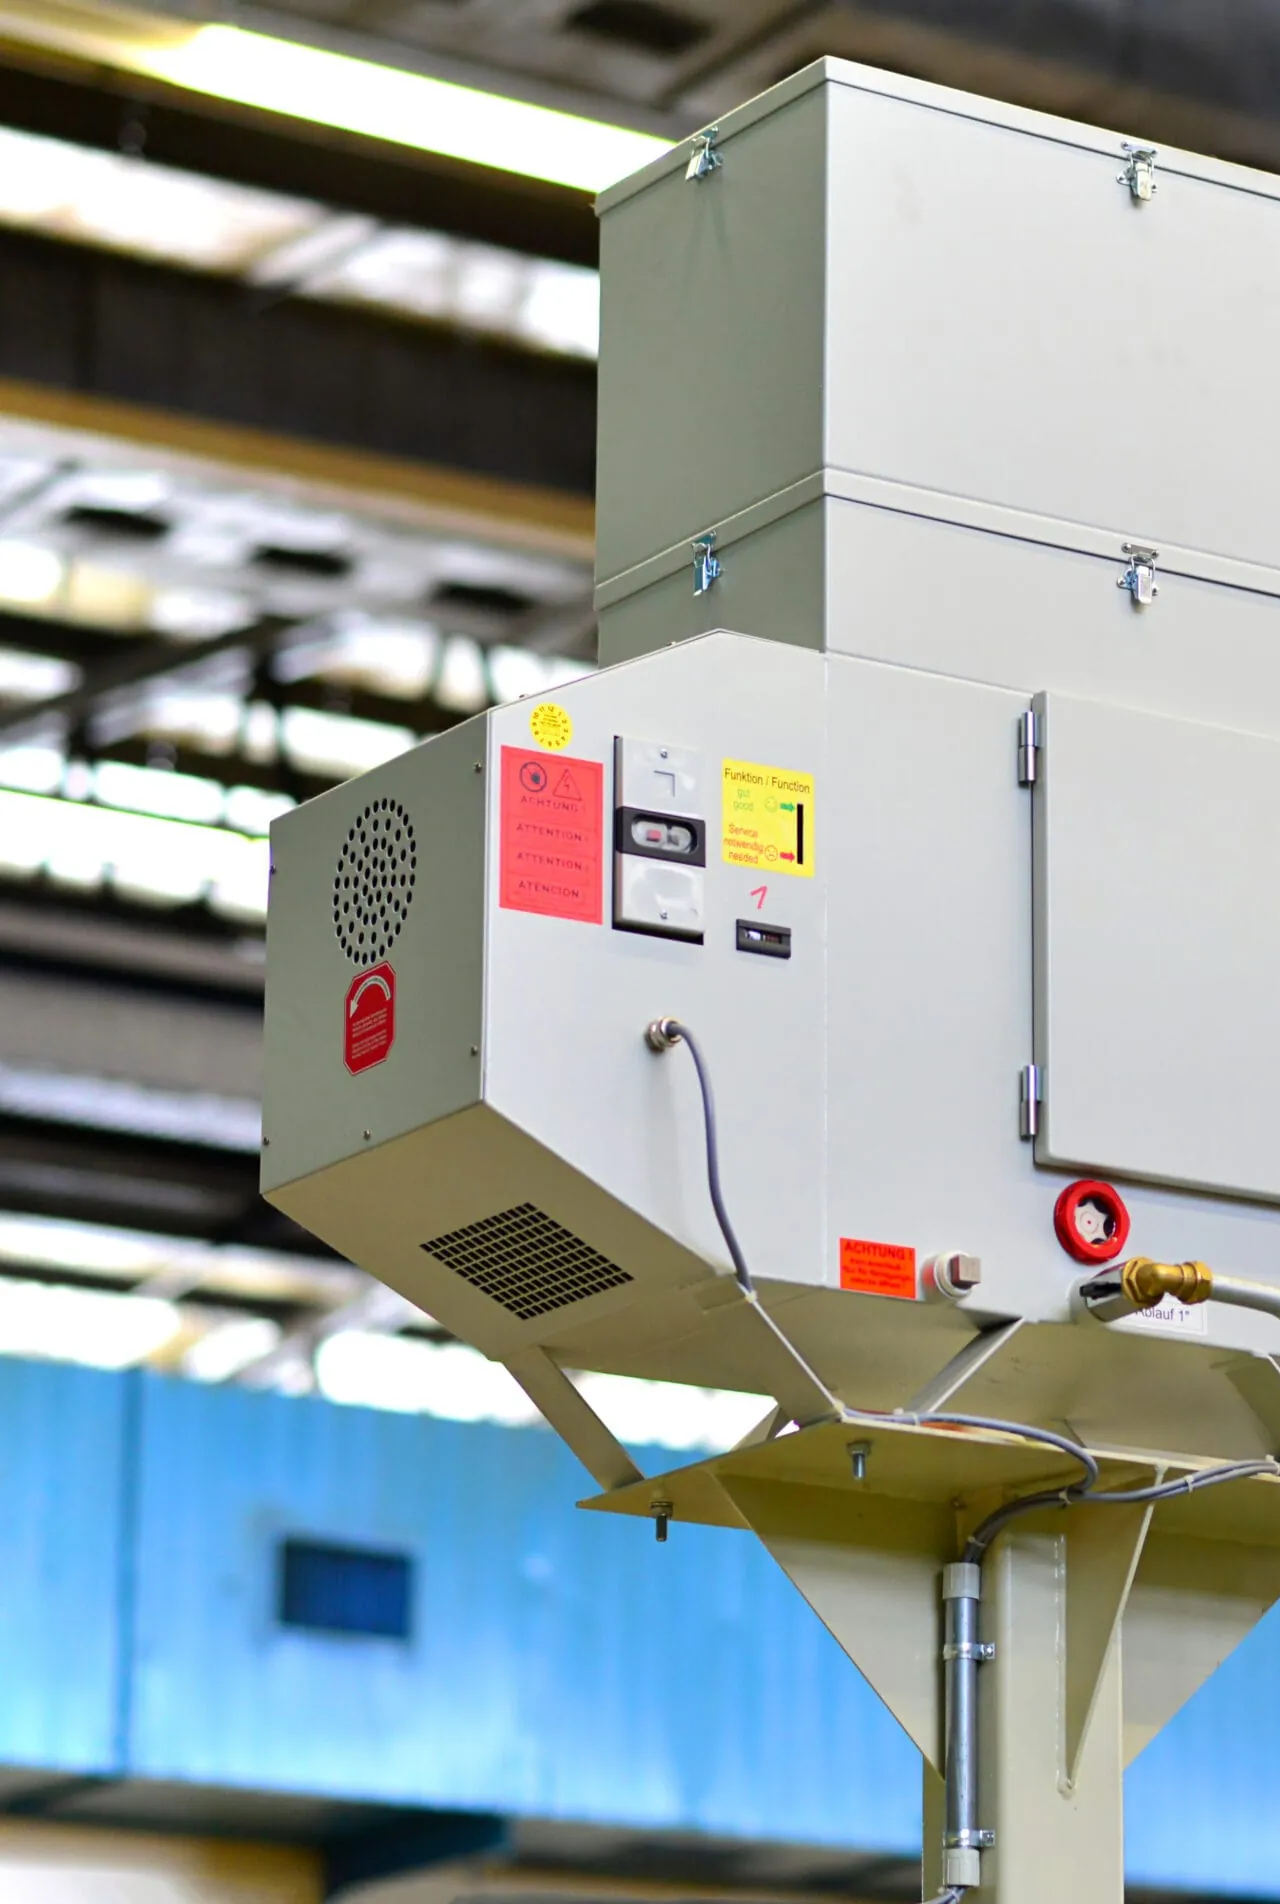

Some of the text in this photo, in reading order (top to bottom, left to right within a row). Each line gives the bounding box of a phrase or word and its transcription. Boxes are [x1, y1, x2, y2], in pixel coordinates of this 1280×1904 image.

[724, 767, 763, 786] Funktion
[771, 776, 811, 794] Function
[520, 795, 579, 813] ACHTUNG
[516, 823, 582, 842] ATTENTION
[728, 823, 758, 839] Service
[723, 838, 764, 855] notwendig
[517, 851, 582, 871] ATTENTION
[728, 851, 759, 865] needed
[844, 1241, 905, 1261] ACHTUNG
[1136, 1308, 1174, 1321] blauf
